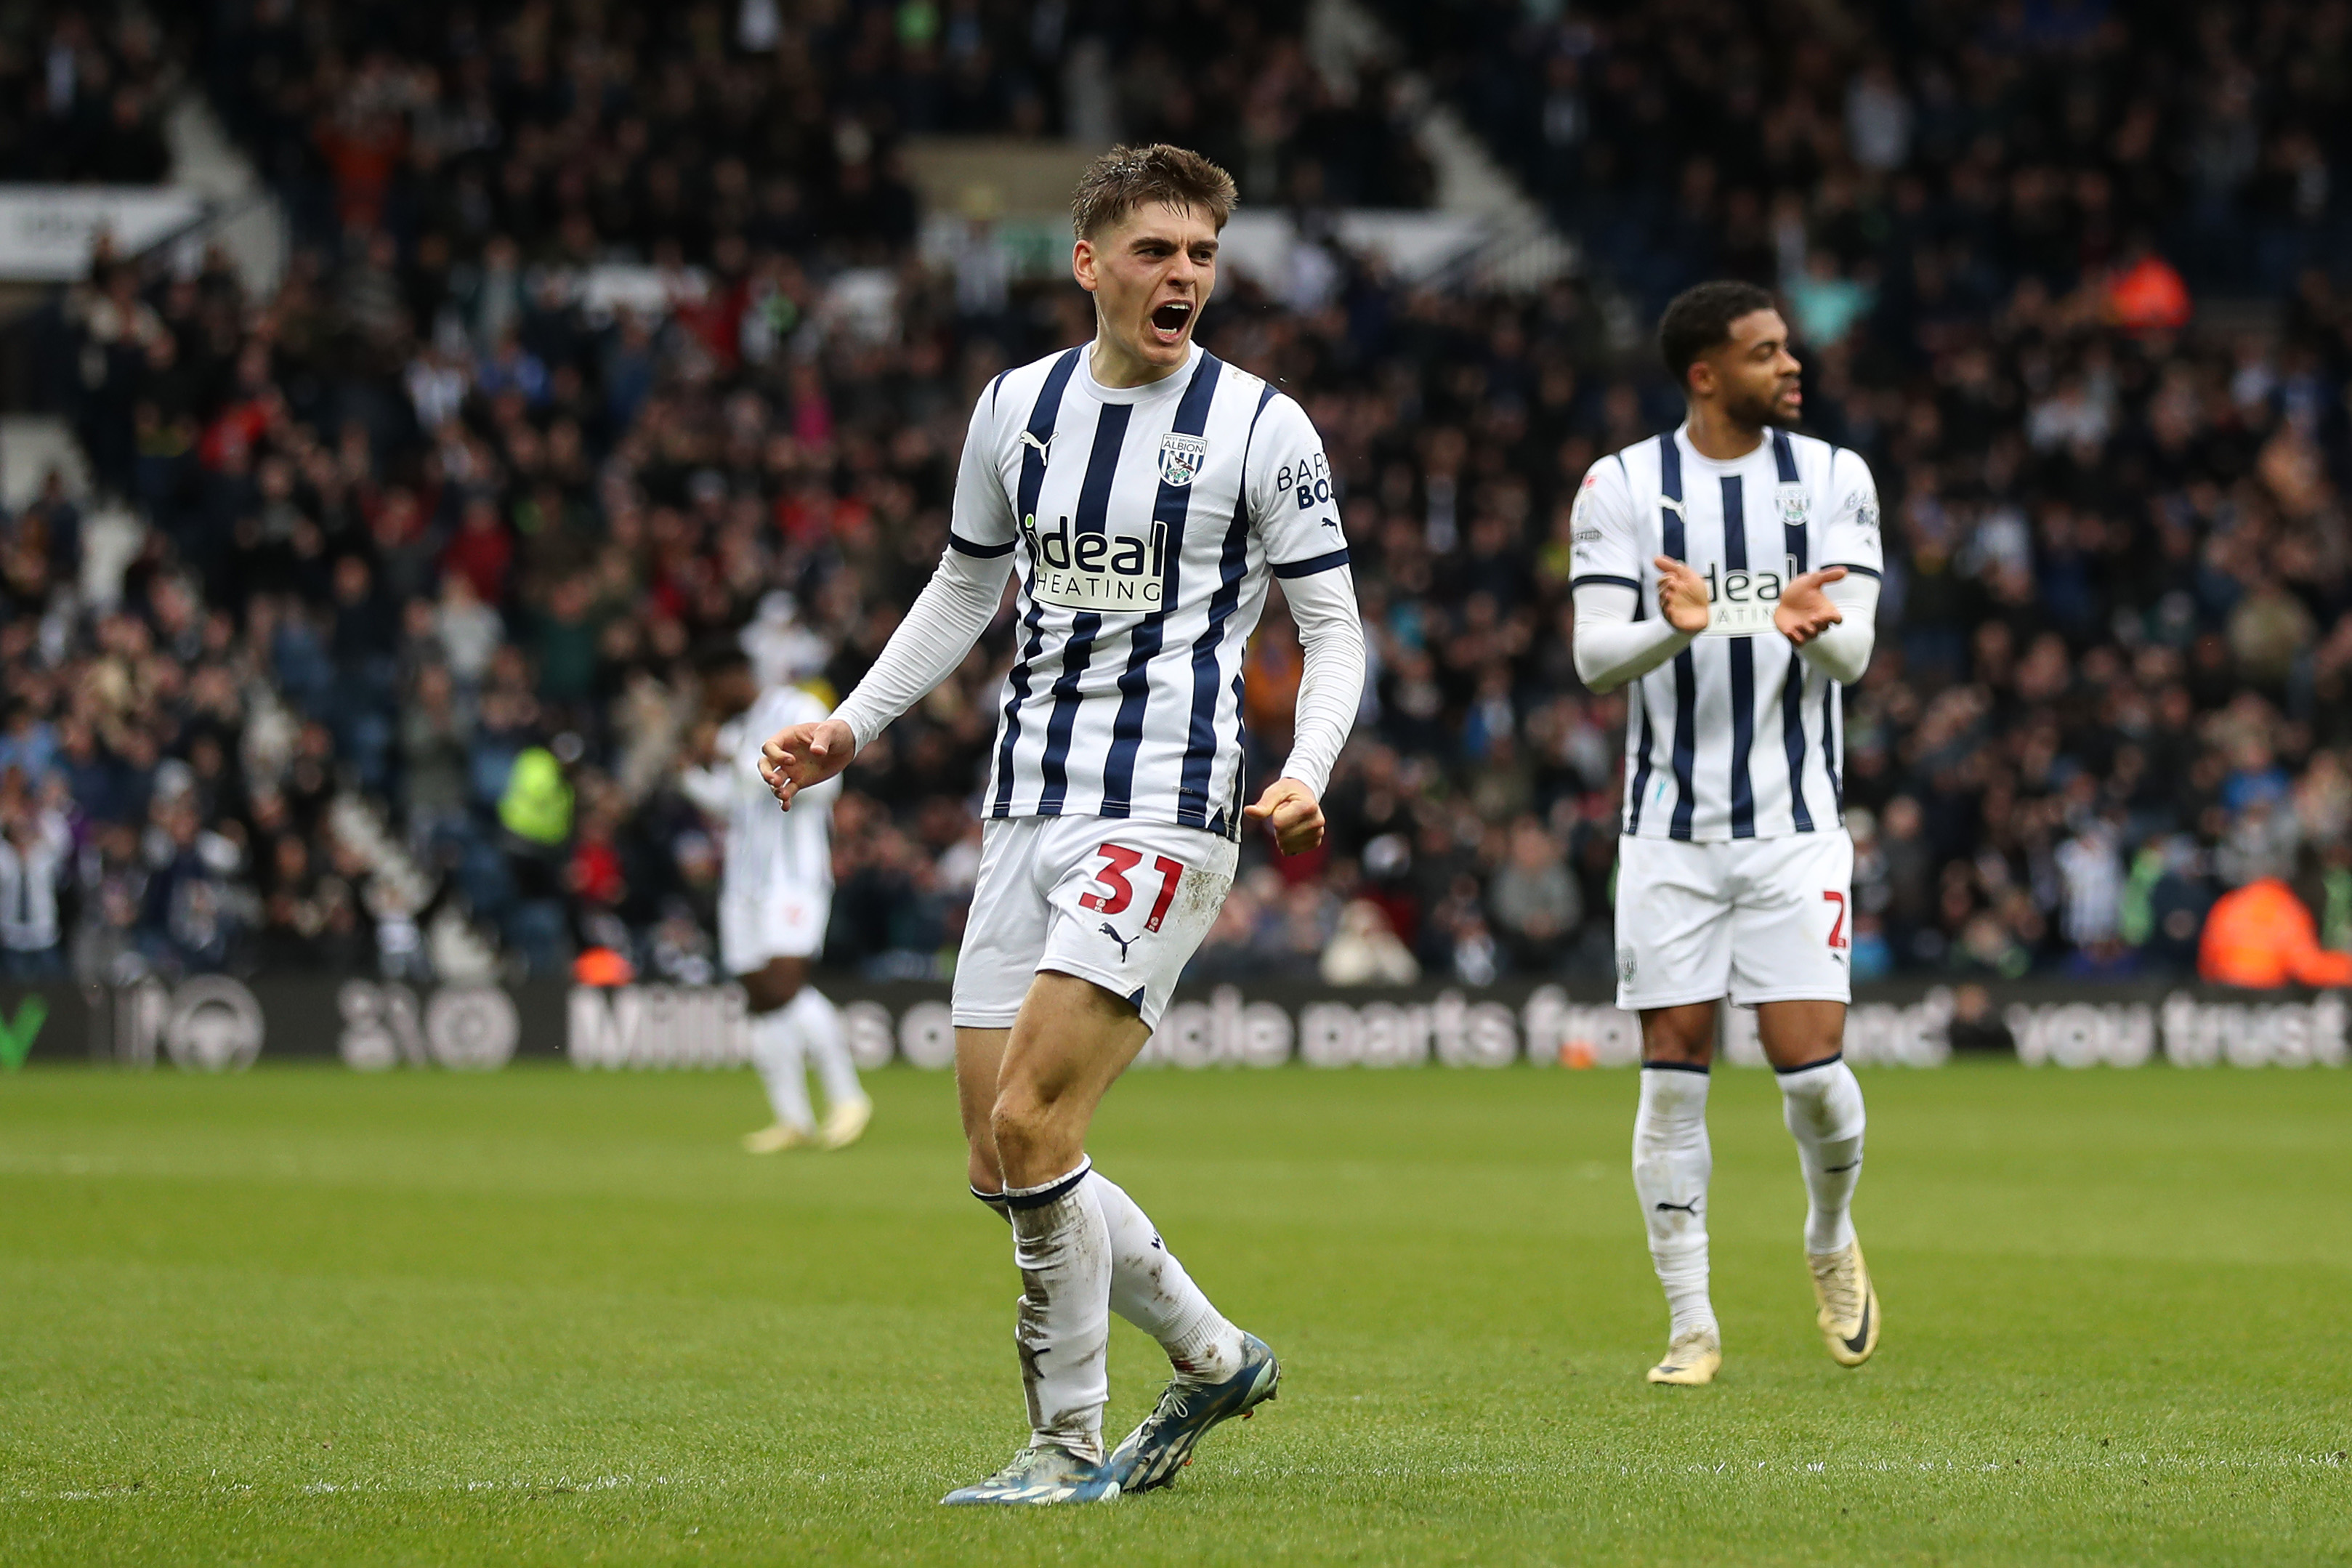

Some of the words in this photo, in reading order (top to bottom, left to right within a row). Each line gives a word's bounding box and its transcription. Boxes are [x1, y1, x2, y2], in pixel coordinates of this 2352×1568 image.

[1163, 440, 1204, 453] ALBION
[1277, 453, 1328, 492] BAR
[1296, 479, 1333, 510] BO
[1025, 514, 1167, 577] ideal
[1036, 573, 1160, 602] HEATING
[1702, 557, 1797, 603] deal
[1715, 608, 1774, 625] ATIN
[1079, 843, 1184, 933] 31
[1824, 891, 1846, 947] 2
[1298, 988, 1519, 1068] parts
[1520, 984, 1644, 1068] fro
[2004, 1001, 2154, 1068] you
[2162, 990, 2347, 1068] trust
